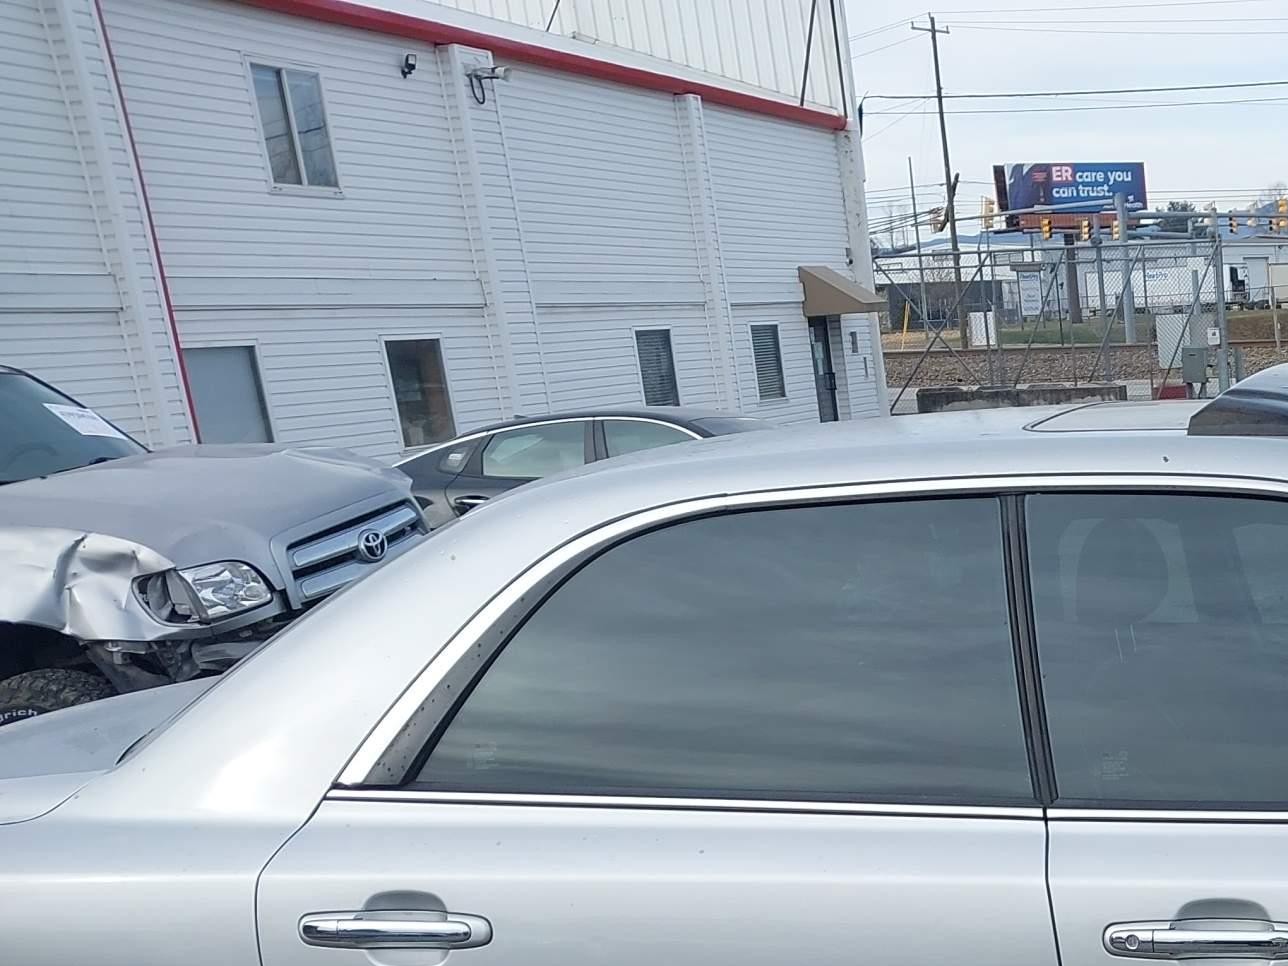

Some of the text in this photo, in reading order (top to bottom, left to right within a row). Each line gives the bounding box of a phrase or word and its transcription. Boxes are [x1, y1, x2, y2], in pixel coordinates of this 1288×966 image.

[1052, 166, 1072, 180] ER
[1076, 172, 1104, 181] care
[1108, 170, 1132, 184] you
[1052, 184, 1113, 197] can trust.
